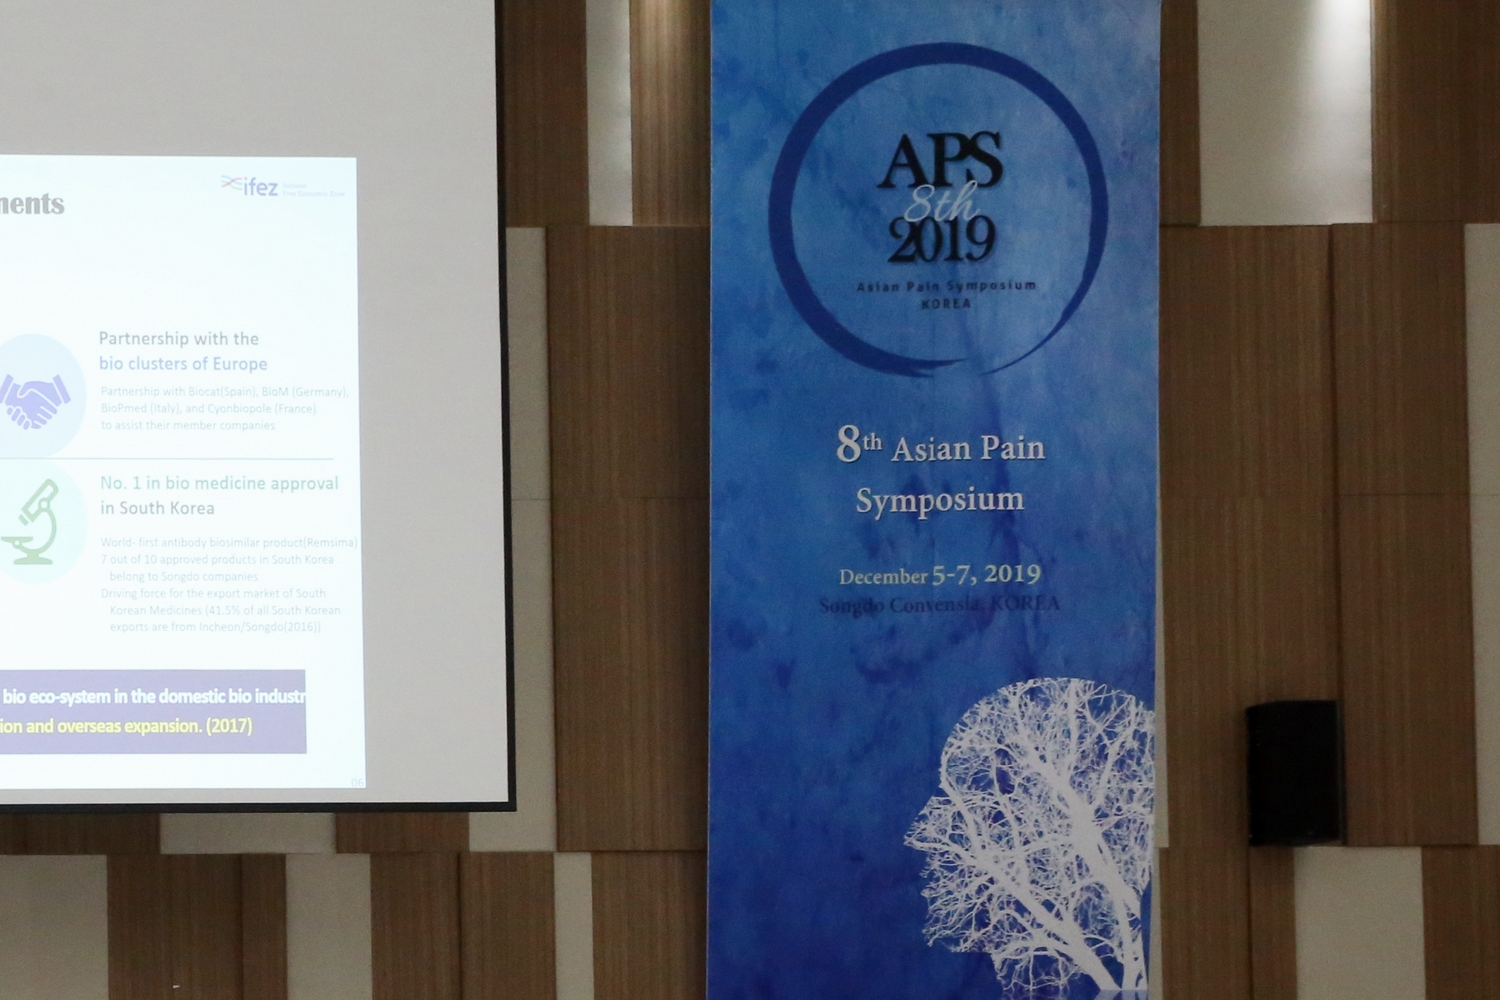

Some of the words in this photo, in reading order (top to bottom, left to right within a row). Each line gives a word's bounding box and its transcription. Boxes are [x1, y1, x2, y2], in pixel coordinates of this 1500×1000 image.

[876, 131, 1003, 189] APS
[244, 177, 278, 196] ifez
[905, 180, 981, 222] 8th
[888, 215, 996, 264] 2019
[857, 281, 900, 292] Asian
[907, 281, 940, 292] Pain
[947, 279, 1036, 294] Symposium
[921, 298, 971, 310] KOREA
[100, 331, 189, 348] Partnership
[194, 331, 228, 345] with
[234, 331, 259, 345] the
[100, 356, 123, 370] bio
[129, 356, 187, 370] clusters
[192, 356, 208, 370] of
[213, 357, 267, 374] Europe
[101, 421, 112, 430] to
[115, 421, 142, 430] assist
[146, 420, 170, 430] their
[173, 420, 217, 430] member
[220, 420, 275, 432] companies
[837, 425, 882, 463] 8th
[891, 437, 971, 462] Asian
[981, 435, 1046, 460] Pain
[101, 476, 127, 490] No.
[134, 476, 141, 490] 1
[147, 475, 160, 489] in
[166, 475, 190, 490] bio
[195, 475, 266, 490] medicine
[271, 476, 338, 493] approval
[101, 500, 114, 514] in
[120, 501, 165, 515] South
[171, 501, 214, 515] Korea
[856, 486, 1025, 521] Symposium
[840, 568, 928, 585] December
[932, 565, 977, 586] 5-7,
[985, 564, 1042, 585] 2019
[819, 598, 885, 618] Songdo
[991, 595, 1061, 612] KOREA
[3, 688, 26, 704] bio
[29, 690, 111, 707] eco-system
[114, 688, 128, 703] in
[131, 688, 156, 703] the
[159, 687, 226, 703] domestic
[228, 687, 252, 703] bio
[26, 718, 54, 733] and
[58, 721, 122, 733] overseas
[124, 719, 203, 736] expansion.
[205, 716, 254, 736] (2017)
[351, 777, 364, 788] 06
